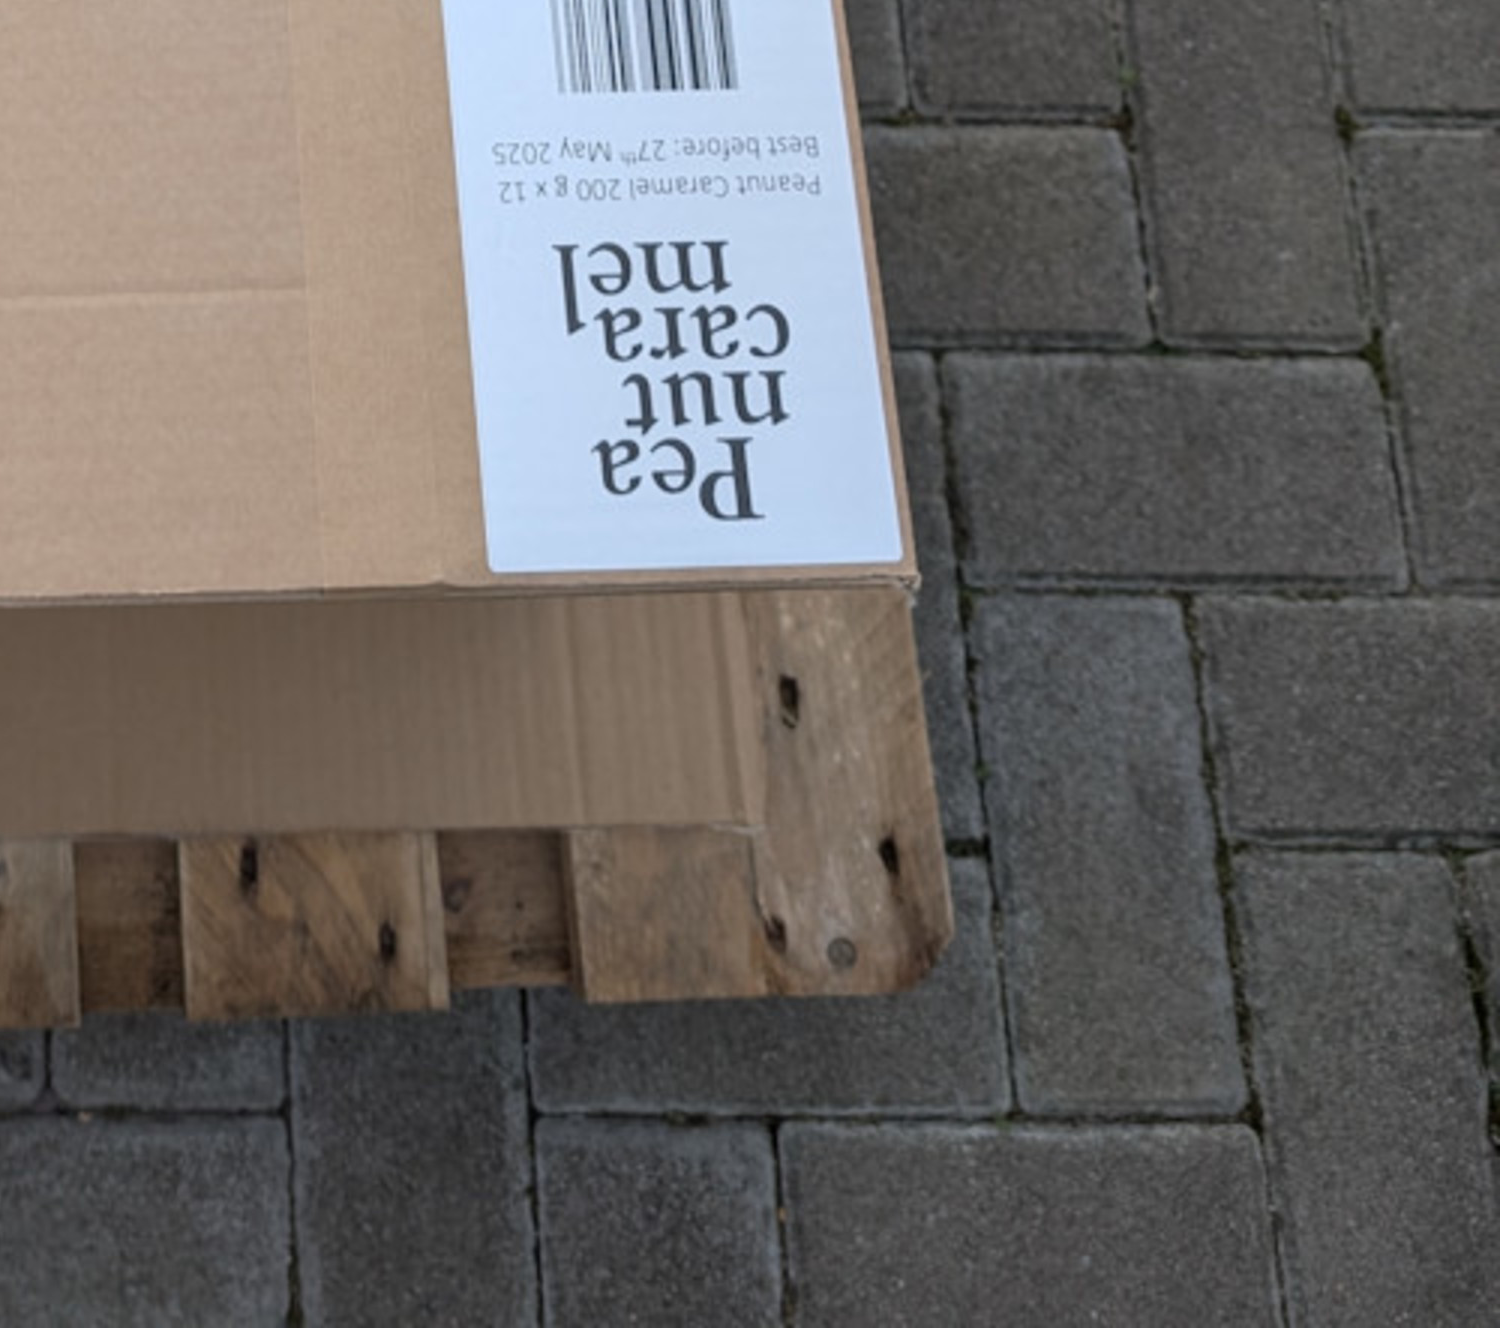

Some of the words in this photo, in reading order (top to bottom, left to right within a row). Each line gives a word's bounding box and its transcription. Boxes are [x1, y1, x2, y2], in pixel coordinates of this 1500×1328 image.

[491, 141, 551, 166] 2025
[560, 137, 612, 162] May
[619, 138, 667, 167] 27th
[673, 136, 761, 163] before:
[766, 134, 821, 159] Best
[497, 180, 527, 205] 12
[536, 181, 547, 196] x
[553, 174, 569, 198] g
[575, 177, 622, 203] 200
[629, 175, 730, 200] Caramel
[735, 172, 822, 196] Peanut
[551, 241, 733, 336] mel
[593, 304, 790, 362] cara
[622, 371, 789, 435] nut
[590, 437, 768, 520] Pea
